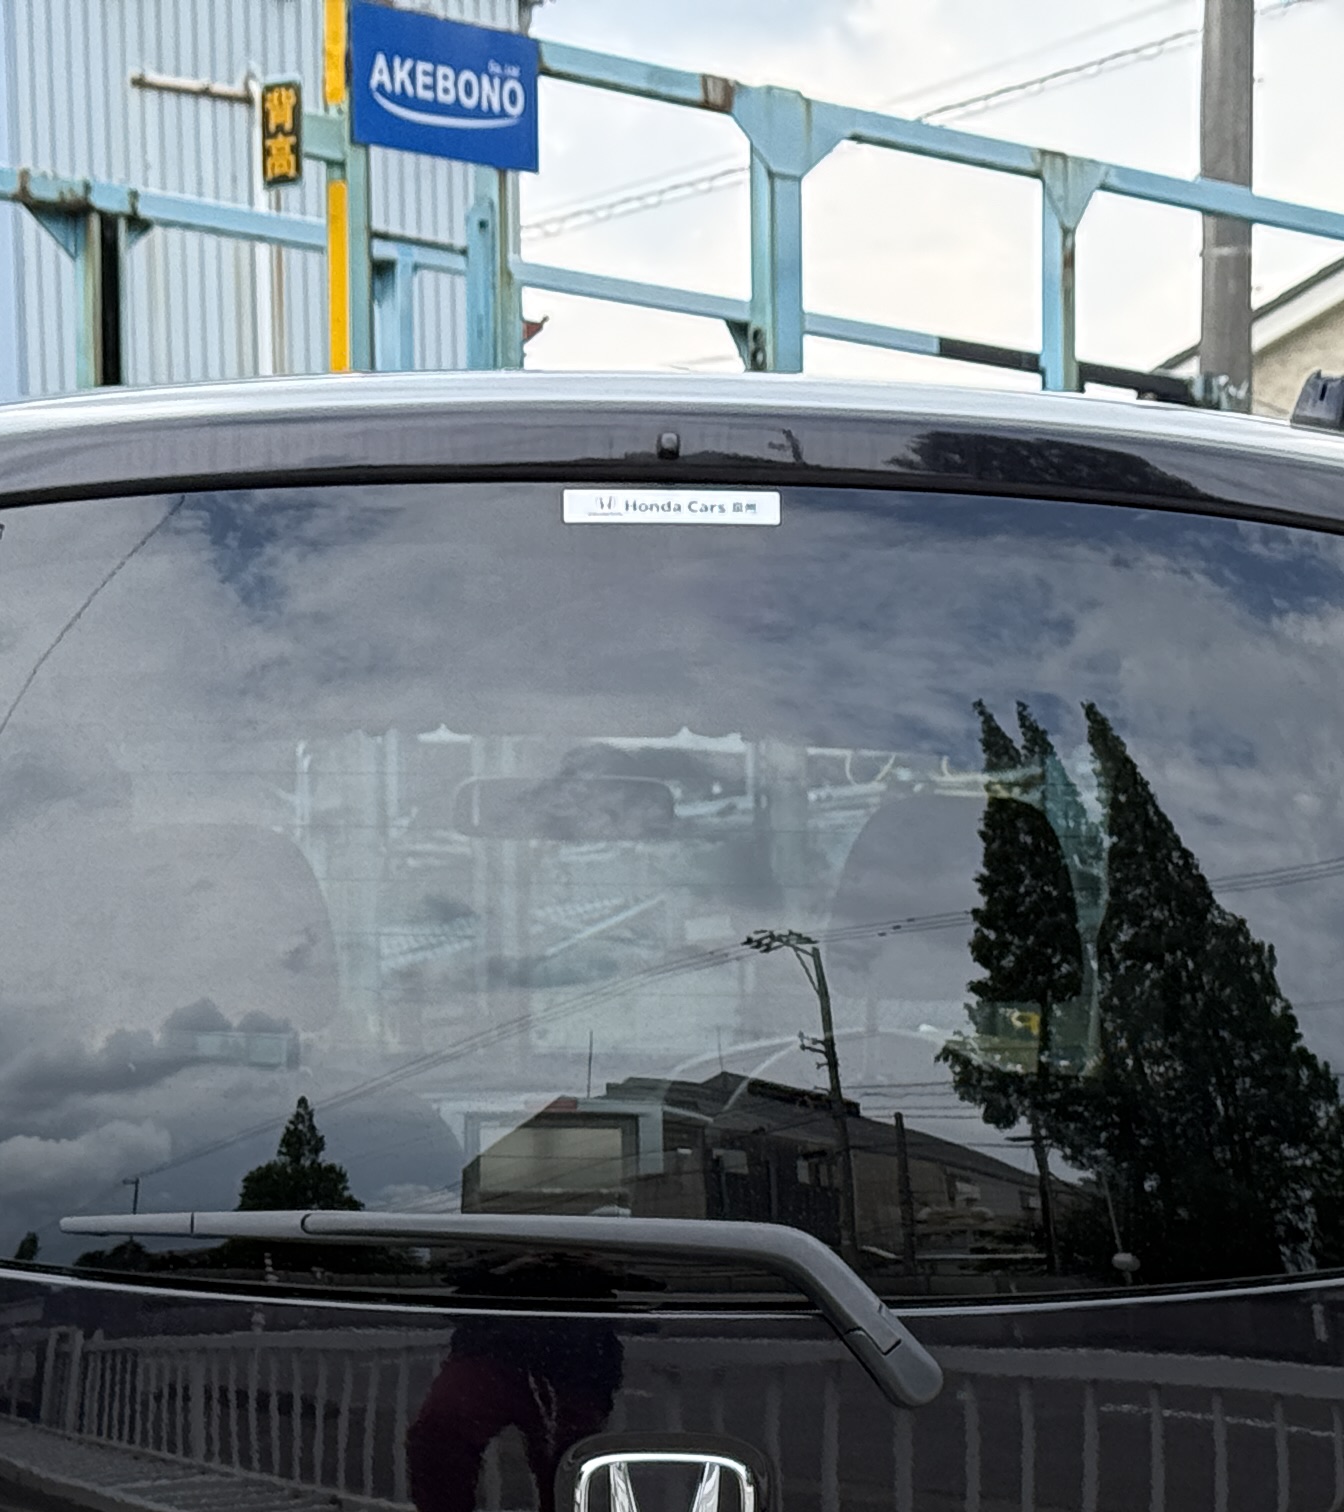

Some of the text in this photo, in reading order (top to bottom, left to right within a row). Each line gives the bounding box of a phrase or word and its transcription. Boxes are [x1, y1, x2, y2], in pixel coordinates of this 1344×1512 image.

[370, 51, 525, 117] AKEBONO
[265, 87, 297, 181] 背高
[624, 499, 682, 513] Honda
[687, 500, 726, 514] Cars
